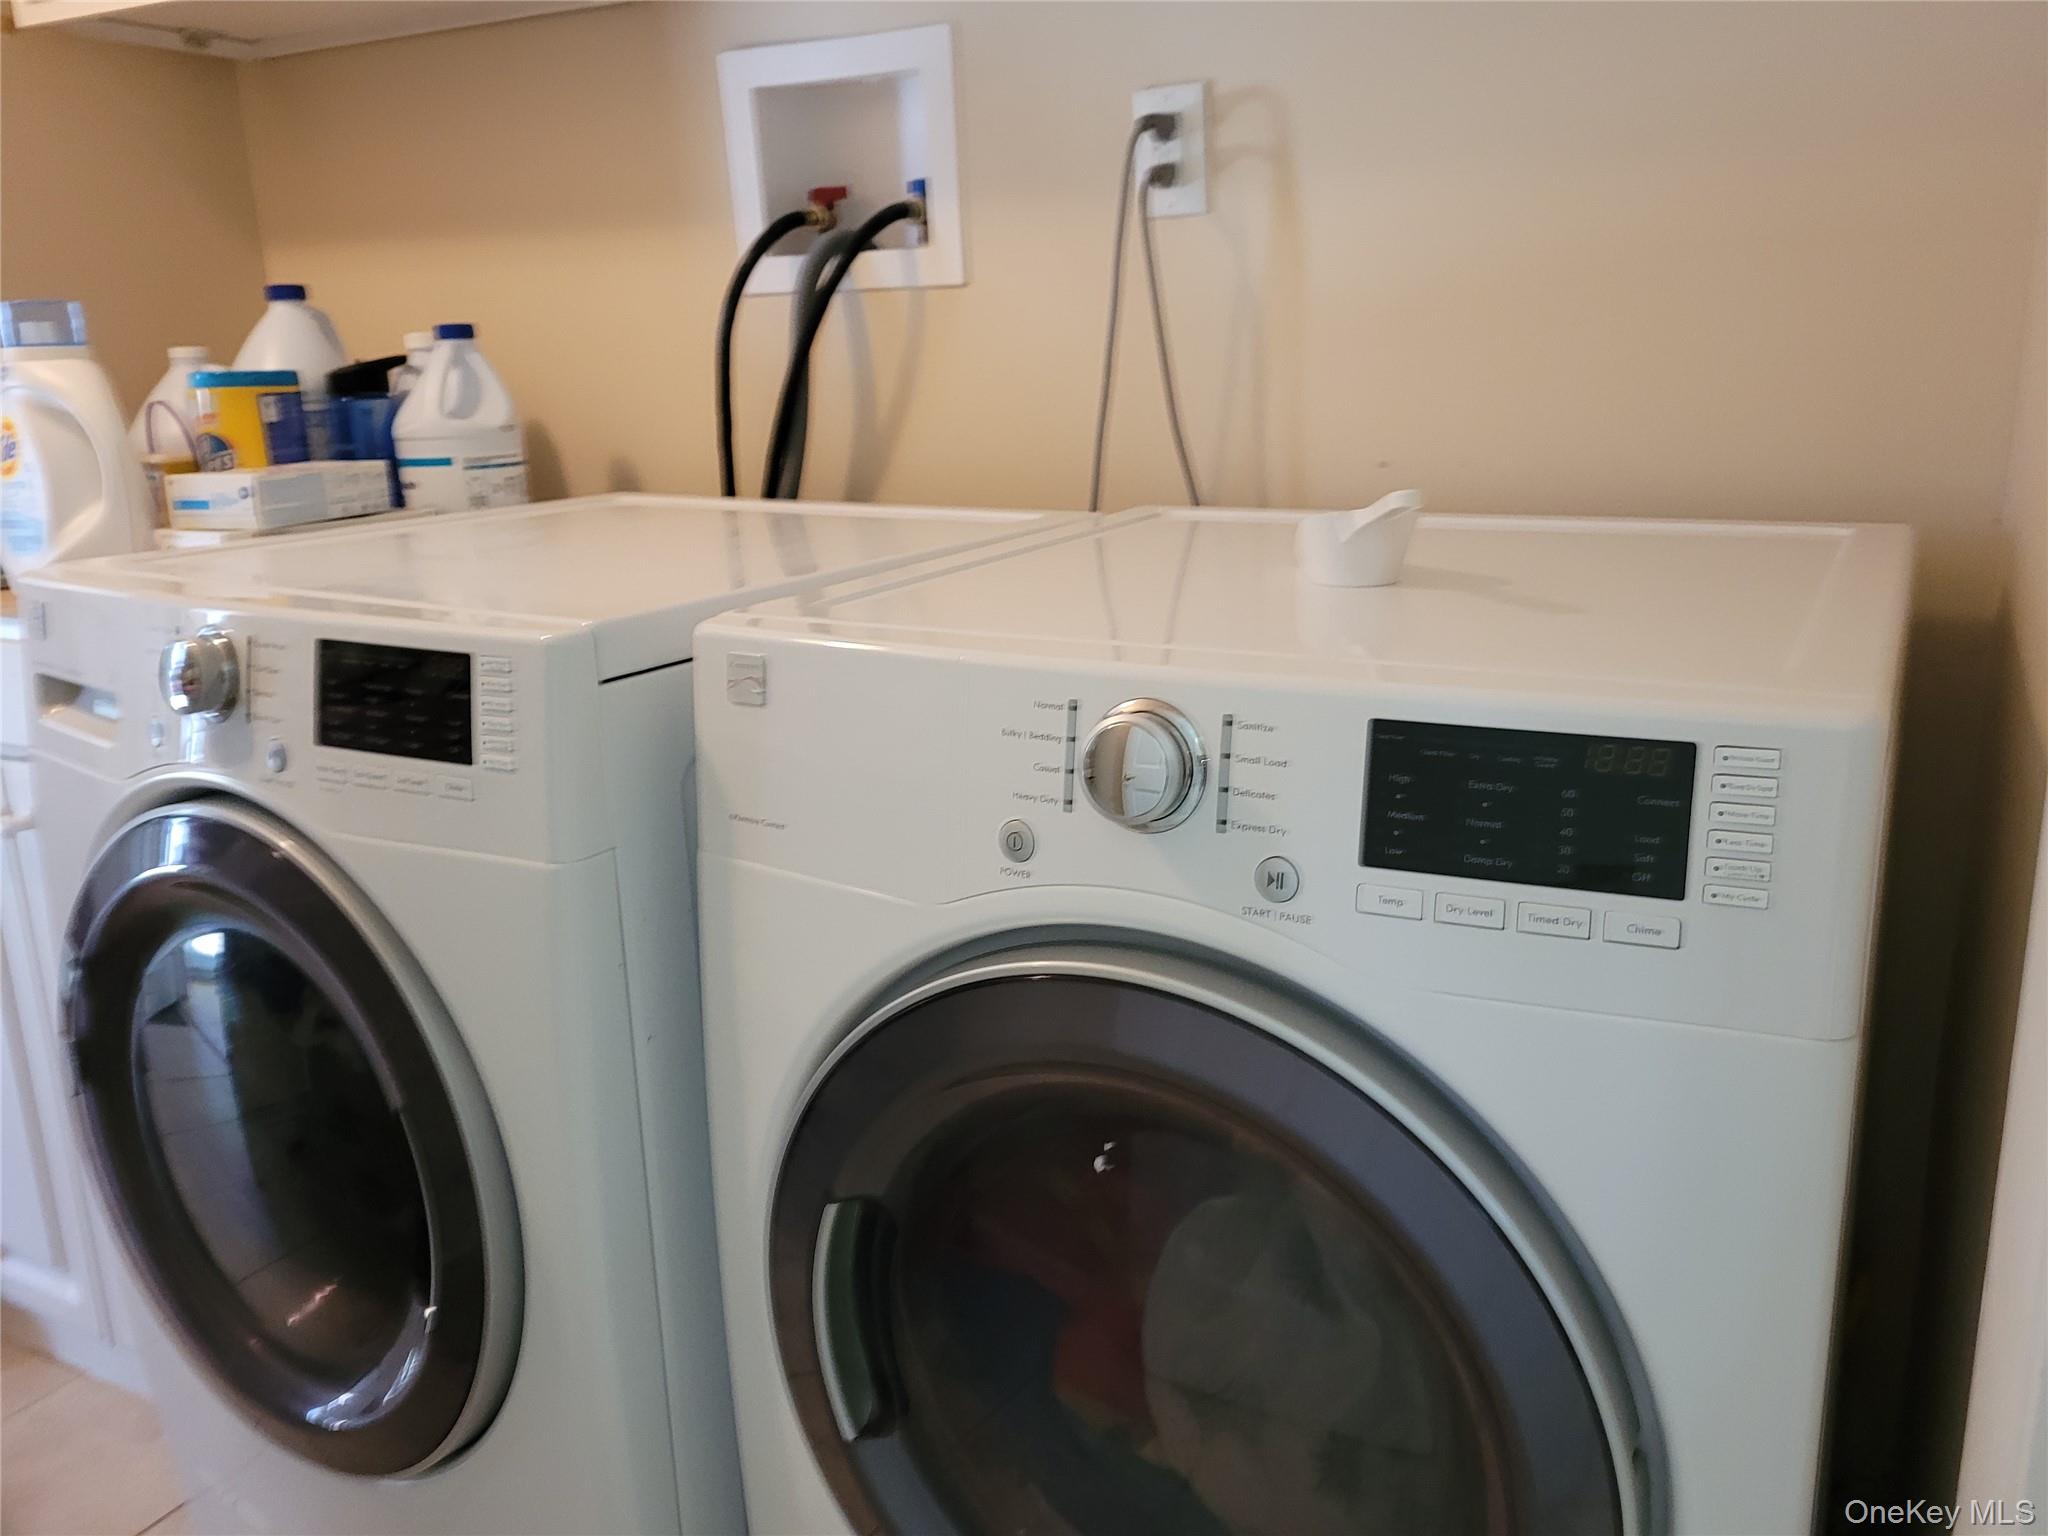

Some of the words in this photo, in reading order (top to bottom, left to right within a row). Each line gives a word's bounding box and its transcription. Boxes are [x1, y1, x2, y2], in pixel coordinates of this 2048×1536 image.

[1234, 754, 1261, 765] Small
[1263, 757, 1287, 768] Load
[1232, 787, 1276, 800] Delicates
[1496, 782, 1515, 793] Dry
[1231, 820, 1266, 834] Express
[1269, 825, 1287, 837] Dry
[1463, 854, 1493, 868] Damp
[1495, 857, 1513, 870] Dry
[1000, 867, 1031, 879] POWER
[1378, 895, 1404, 907] Temp
[1241, 906, 1270, 919] START
[1279, 910, 1312, 924] PAUSE
[1445, 904, 1464, 916] Dry
[1467, 906, 1493, 918] Level
[1528, 913, 1559, 926] Timed
[1563, 916, 1583, 929] Dry
[1626, 923, 1662, 936] Chime
